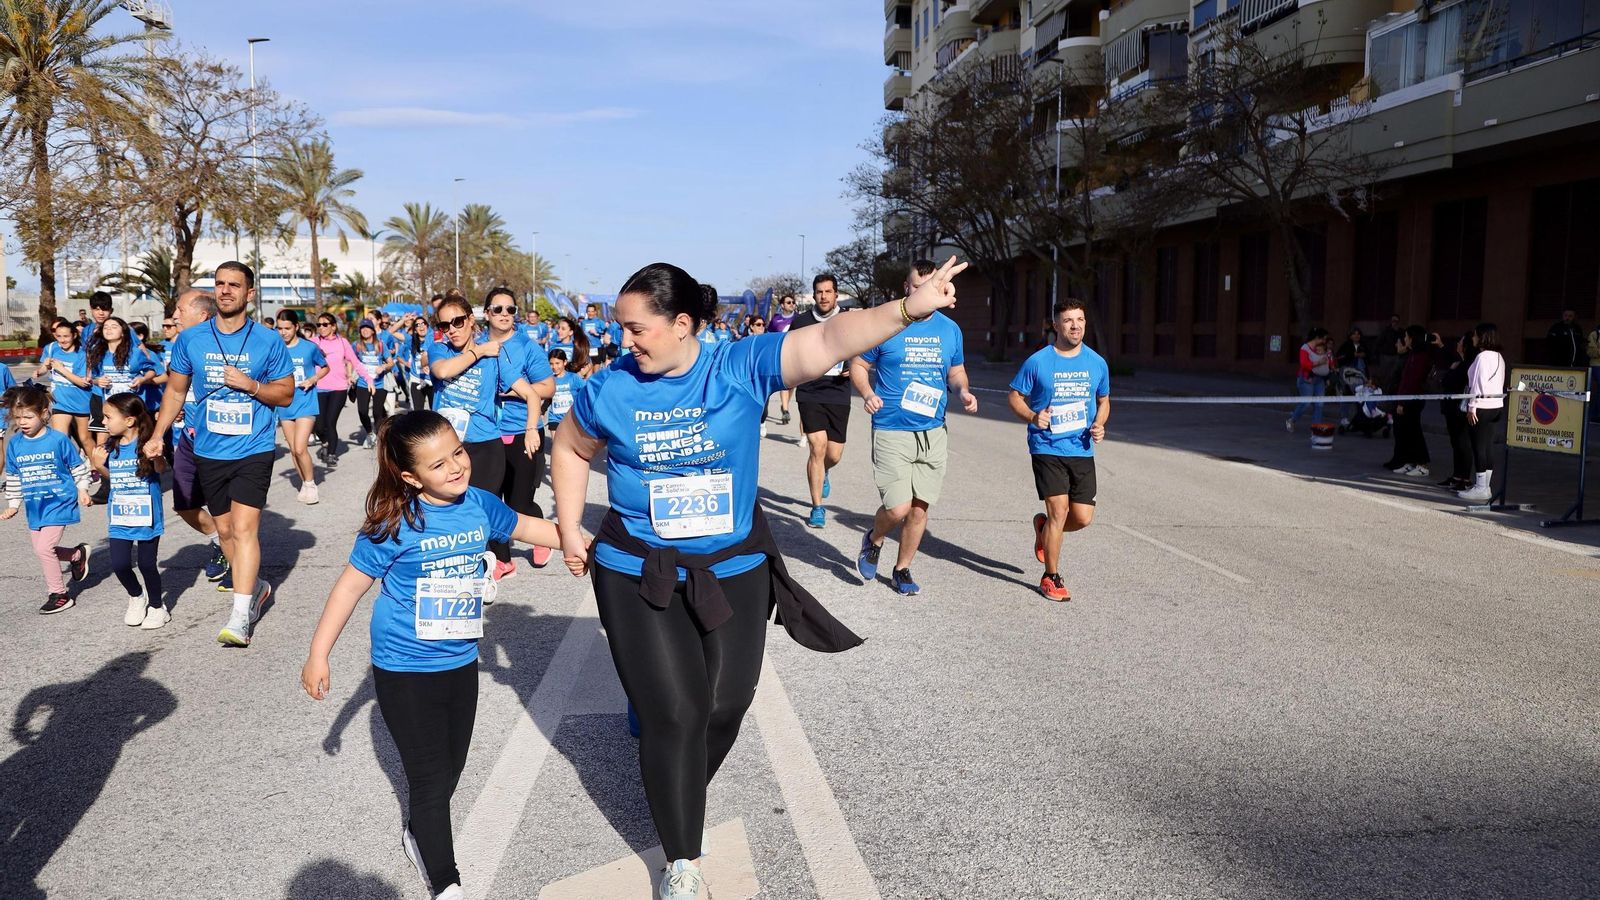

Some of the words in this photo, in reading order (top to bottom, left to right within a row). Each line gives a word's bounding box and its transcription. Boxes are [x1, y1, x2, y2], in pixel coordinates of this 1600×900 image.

[905, 336, 940, 344] mayoral
[206, 352, 249, 362] mayoral
[1054, 371, 1089, 379] mayoral
[913, 392, 934, 406] 1740
[215, 413, 243, 424] 1331
[635, 407, 702, 423] mayora
[635, 421, 705, 443] RUNNING
[1537, 428, 1562, 437] ESTACIONAR
[1561, 431, 1575, 439] DESDE
[642, 433, 703, 453] MAKES
[16, 451, 55, 462] mayoral
[639, 444, 703, 464] FRIENDS
[118, 505, 142, 515] 1821
[668, 495, 718, 516] 2236
[420, 525, 484, 551] mayoral
[434, 598, 476, 617] 1722
